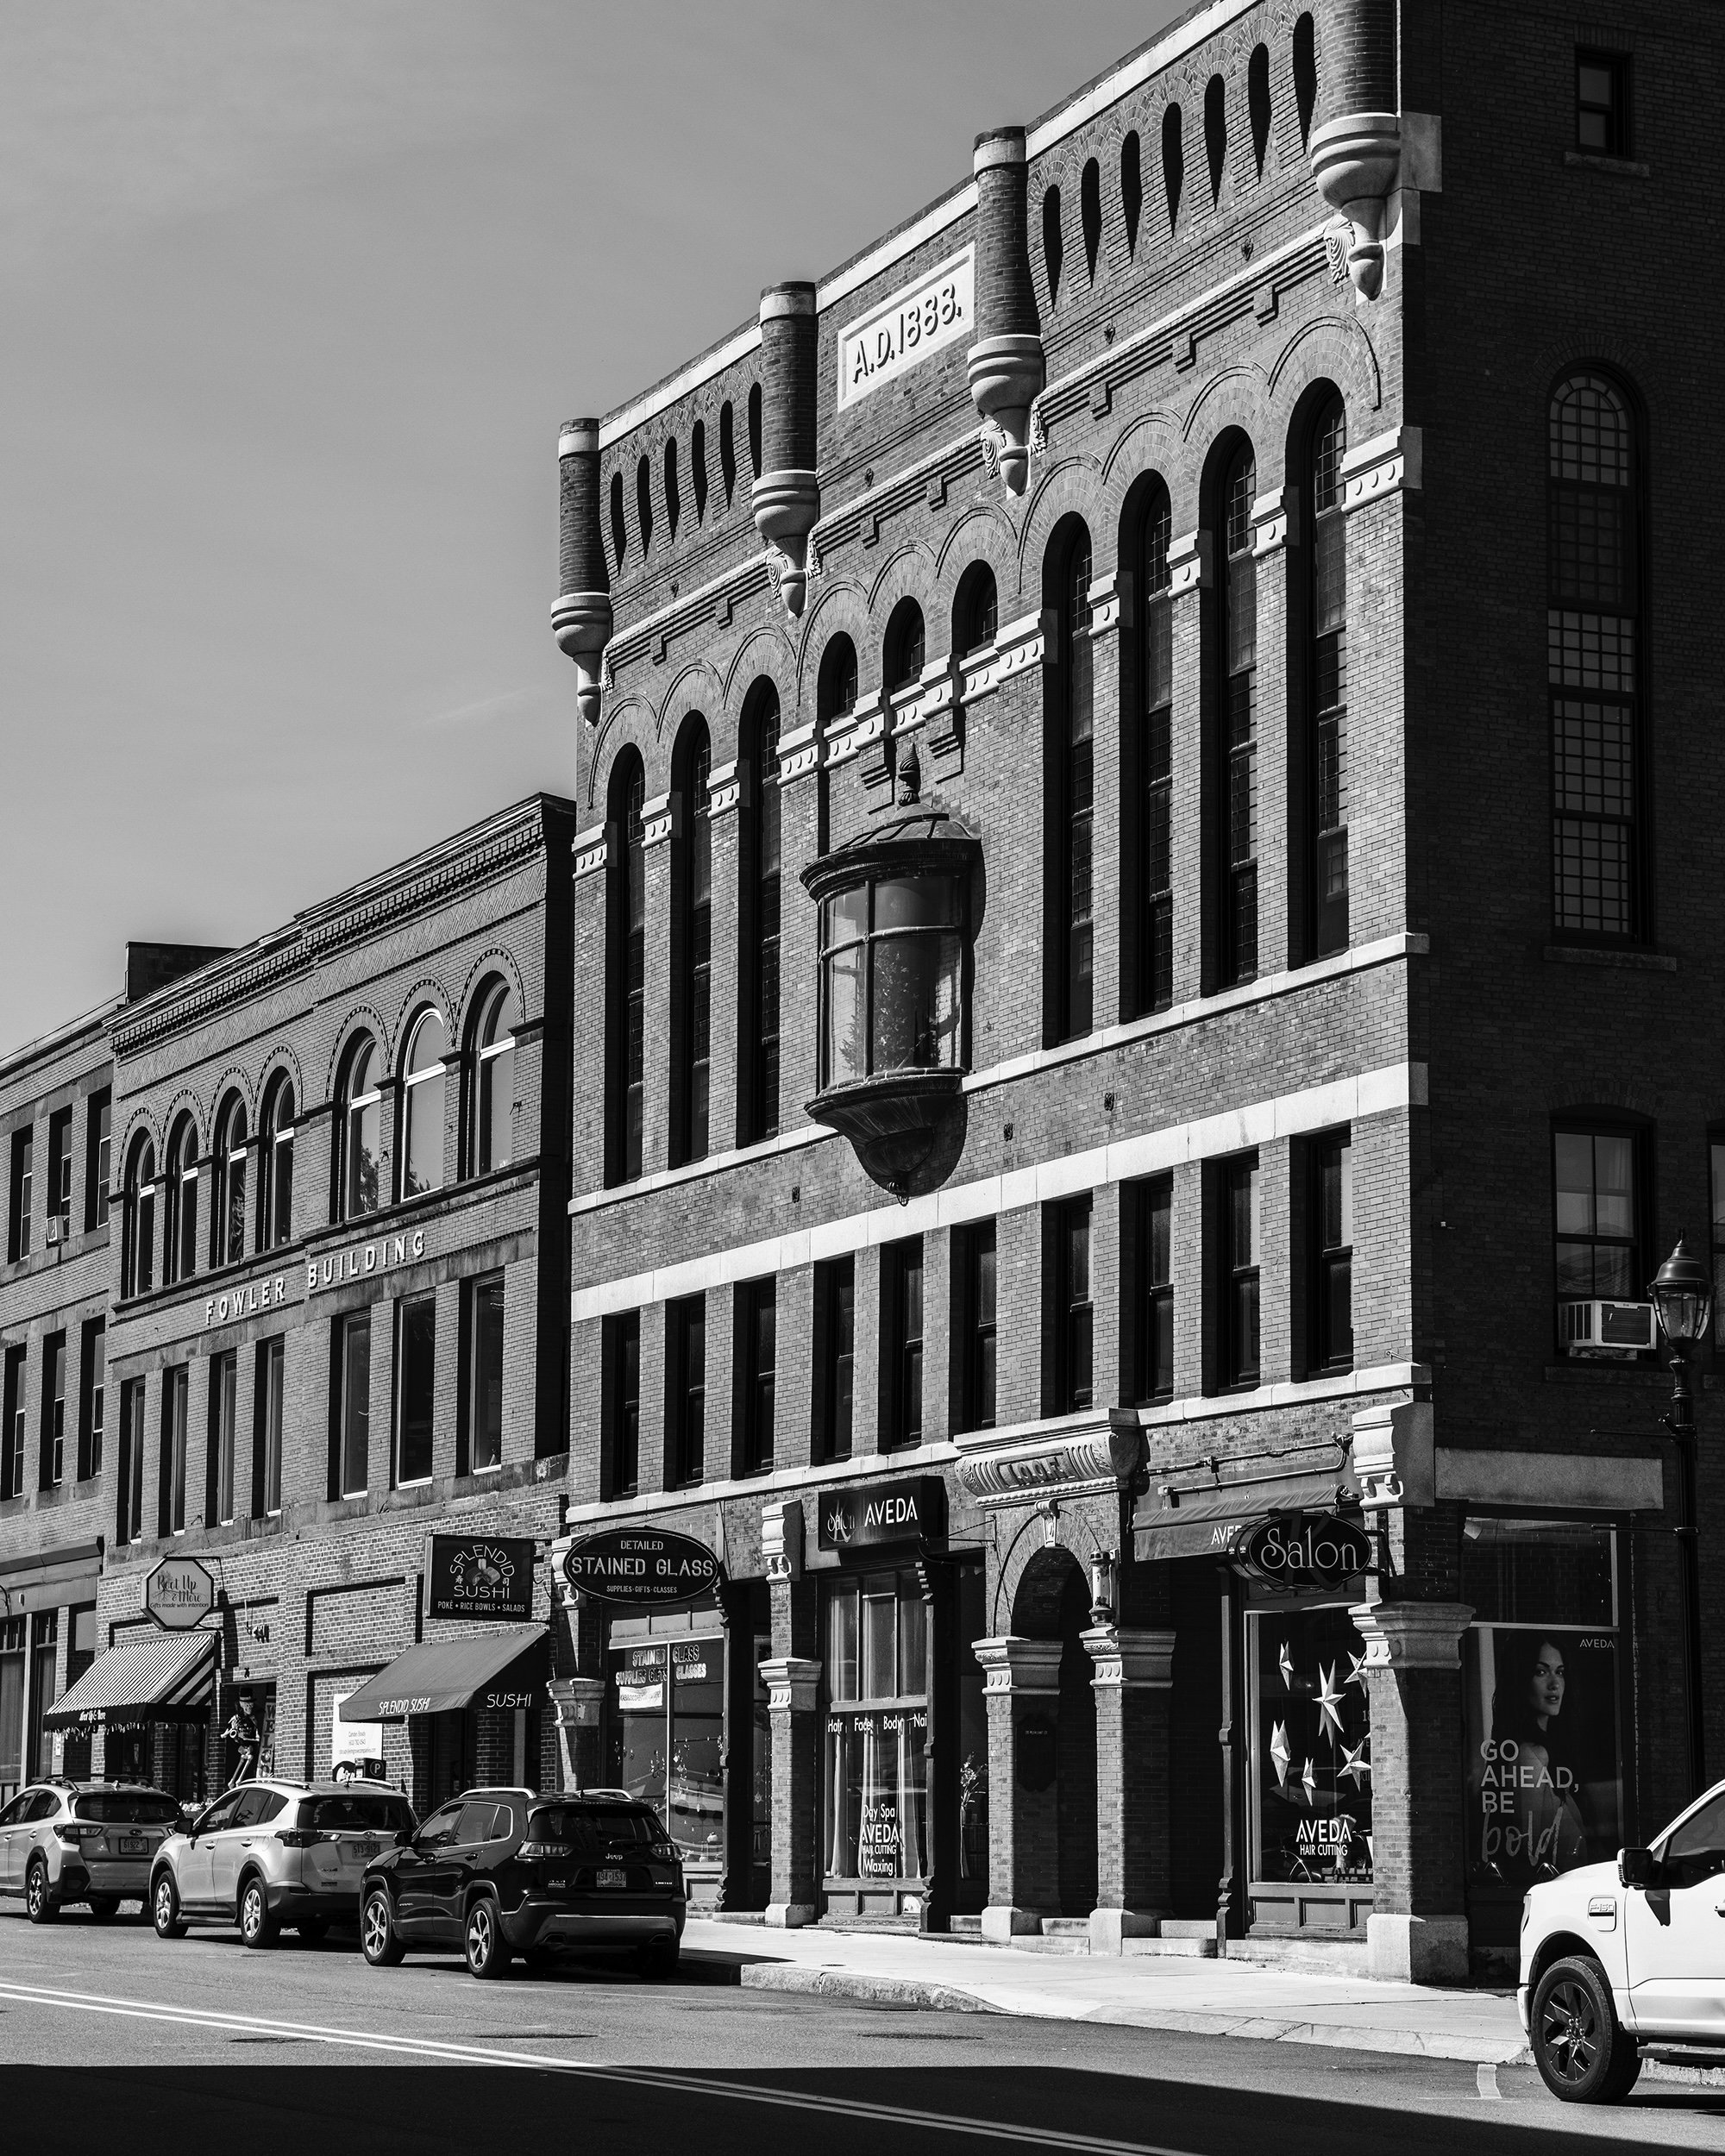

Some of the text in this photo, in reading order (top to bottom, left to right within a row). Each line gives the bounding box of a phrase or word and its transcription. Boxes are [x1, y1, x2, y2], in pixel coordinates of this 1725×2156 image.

[205, 1231, 425, 1326] FOWLER BUILDING
[863, 1495, 919, 1527] AVEDA
[1210, 1524, 1243, 1545] AVE
[620, 1540, 664, 1551] DETAILED
[1260, 1525, 1360, 1571] Salon
[449, 1544, 515, 1577] SPLENDID
[571, 1557, 714, 1577] STAINED GLASS
[454, 1584, 510, 1599] SUSHI
[460, 1601, 474, 1611] RICE
[474, 1602, 496, 1612] BOWLS
[502, 1603, 525, 1613] SALADS
[1579, 1639, 1615, 1649] AVEDA
[632, 1644, 700, 1668] STAINED GLASS
[615, 1669, 647, 1686] SUPPLIES
[378, 1697, 431, 1715] SPLENDID SUSHI
[486, 1693, 532, 1708] SUSHI
[827, 1718, 844, 1733] Hair
[883, 1714, 903, 1735] Body
[913, 1713, 928, 1728] Nai
[260, 1703, 277, 1779] WELCO
[1480, 1739, 1520, 1762] GO
[373, 1763, 381, 1775] P
[1480, 1764, 1579, 1793] AHEAD,
[862, 1803, 895, 1821] Day Spa
[1482, 1791, 1515, 1814] BE
[860, 1823, 900, 1844] AVEDA
[1295, 1819, 1352, 1843] AVEDA
[1481, 1803, 1565, 1867] bold
[605, 1852, 624, 1861] Jeep
[874, 1844, 897, 1855] CUTTING
[1300, 1844, 1348, 1856] HAIR CUTTING
[863, 1858, 894, 1877] Waxing
